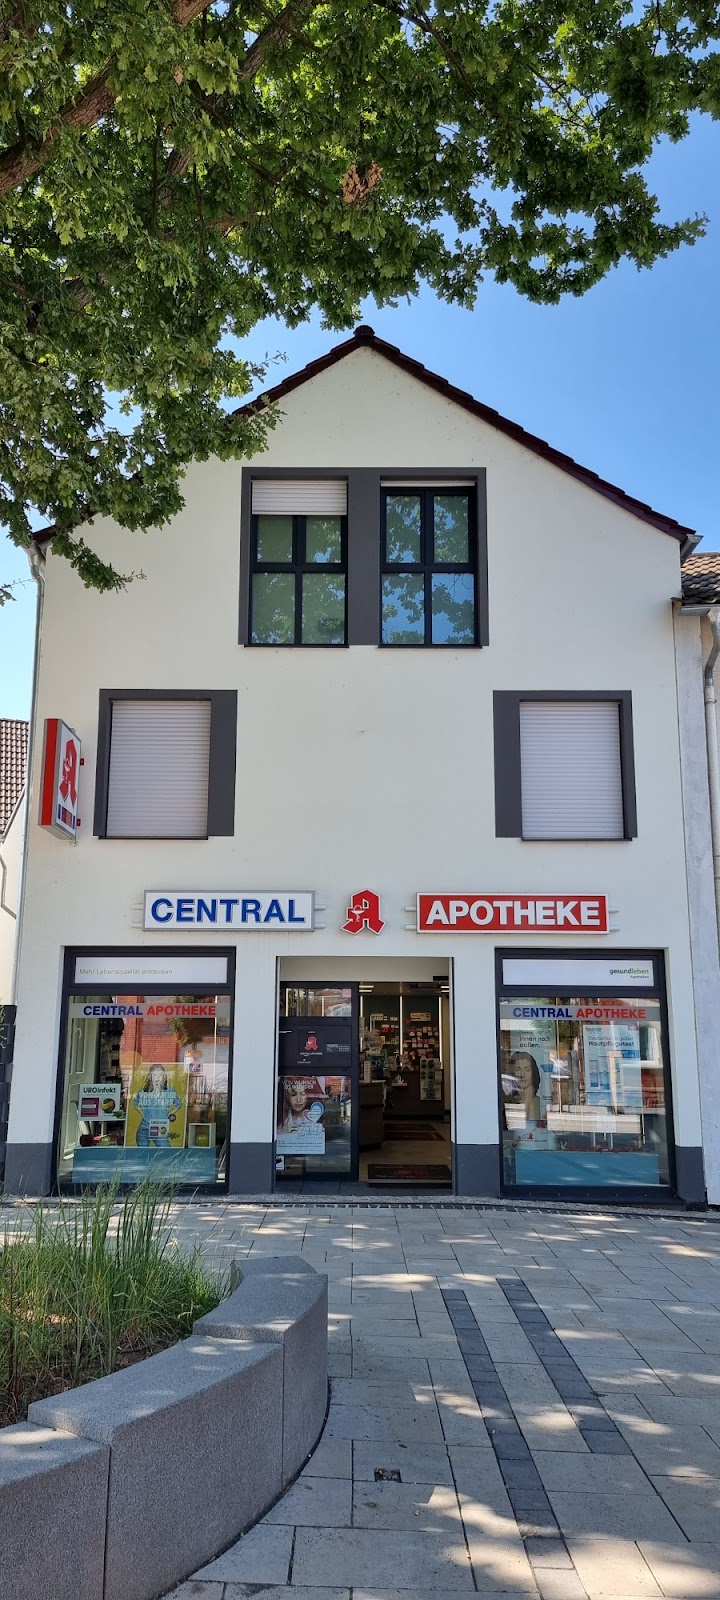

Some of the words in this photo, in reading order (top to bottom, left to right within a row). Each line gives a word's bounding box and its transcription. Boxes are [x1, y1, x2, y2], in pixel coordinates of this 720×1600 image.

[150, 897, 306, 924] CENTRAL
[425, 899, 600, 926] APOTHEKE
[79, 968, 95, 976] Mehr
[96, 967, 140, 977] Lebensqualität
[141, 967, 173, 976] entdecken
[609, 967, 649, 976] gesundleben
[83, 1005, 143, 1016] CENTRAL
[146, 1005, 216, 1016] APOTHEKE
[512, 1007, 572, 1018] CENTRAL
[576, 1008, 646, 1019] APOTHEKE
